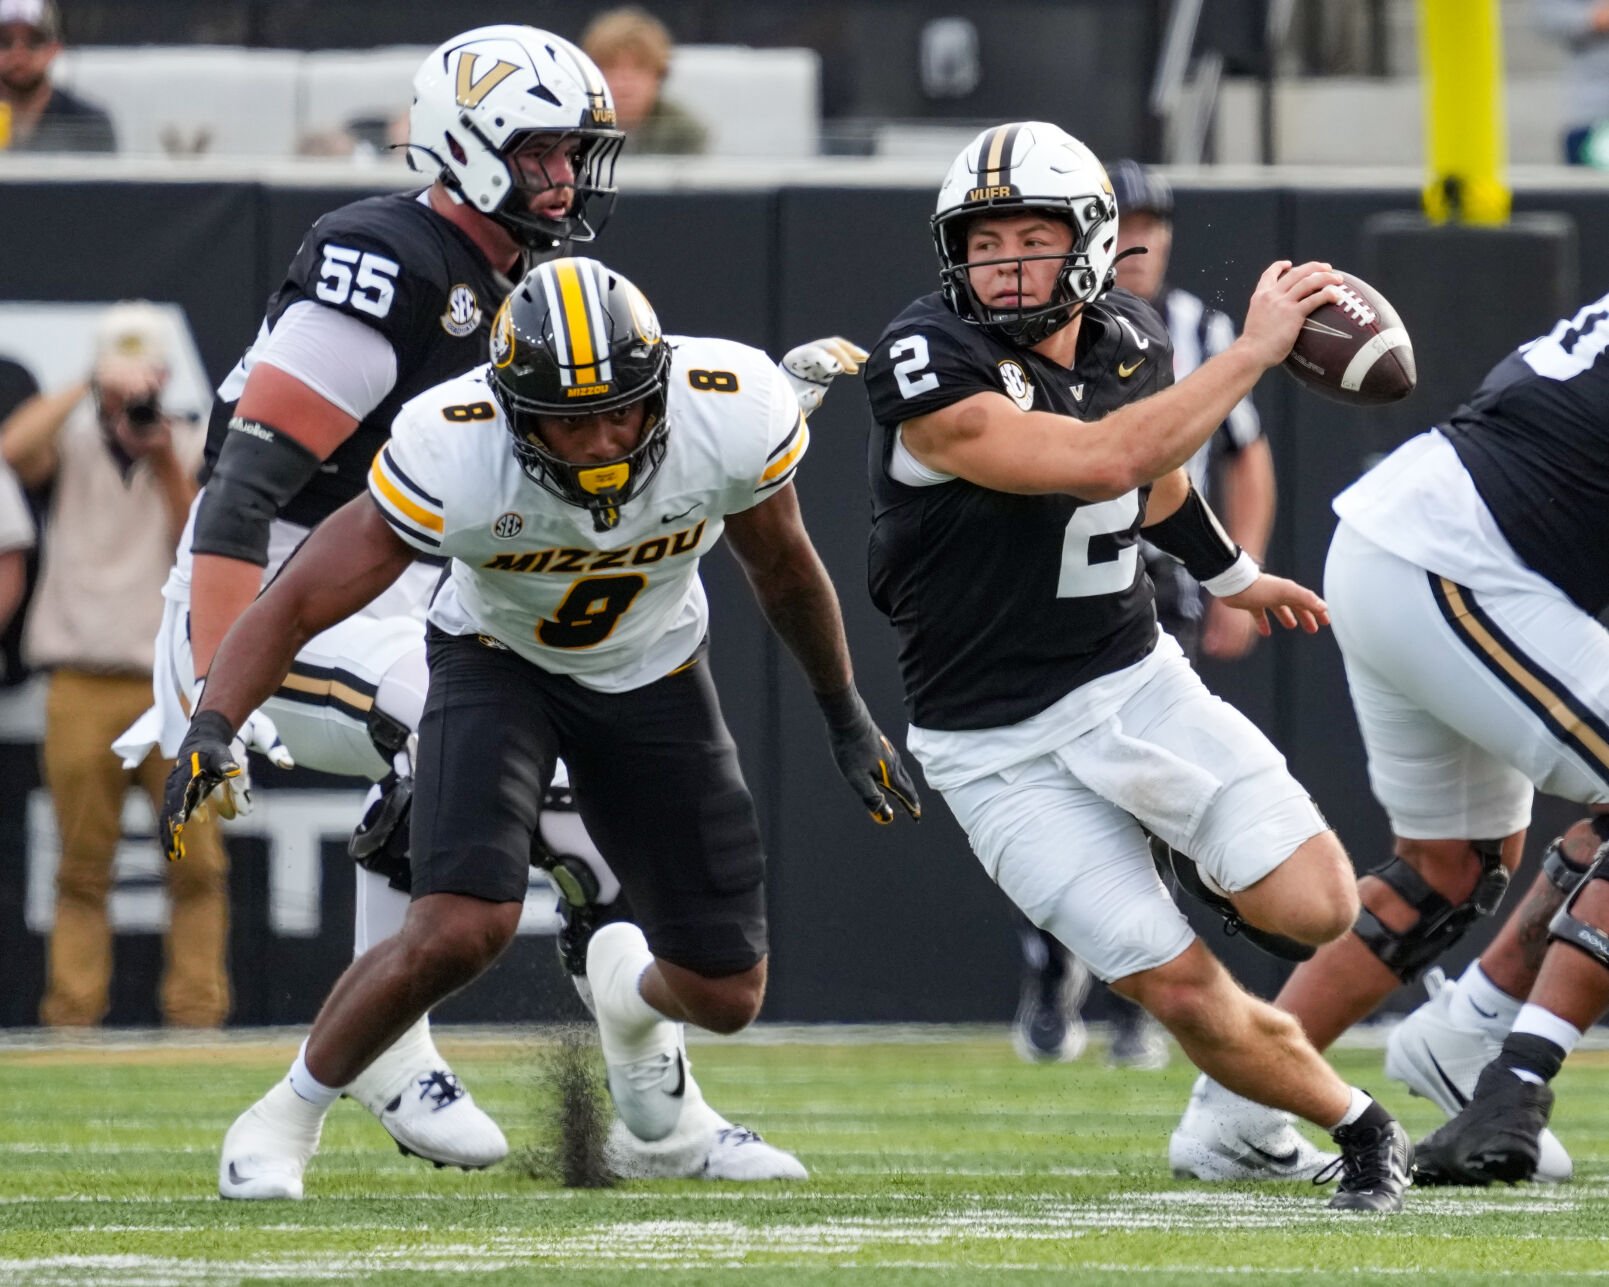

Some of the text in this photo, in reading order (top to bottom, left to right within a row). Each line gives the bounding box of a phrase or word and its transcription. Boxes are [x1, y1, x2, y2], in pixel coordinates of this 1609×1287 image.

[456, 51, 523, 110] V
[316, 244, 400, 319] 55
[889, 334, 940, 400] 2
[567, 384, 609, 398] MIZZOU
[688, 368, 741, 394] 8
[1069, 383, 1085, 402] V
[441, 400, 497, 424] 8
[494, 513, 522, 538] SEC
[480, 517, 709, 574] MIZZOU
